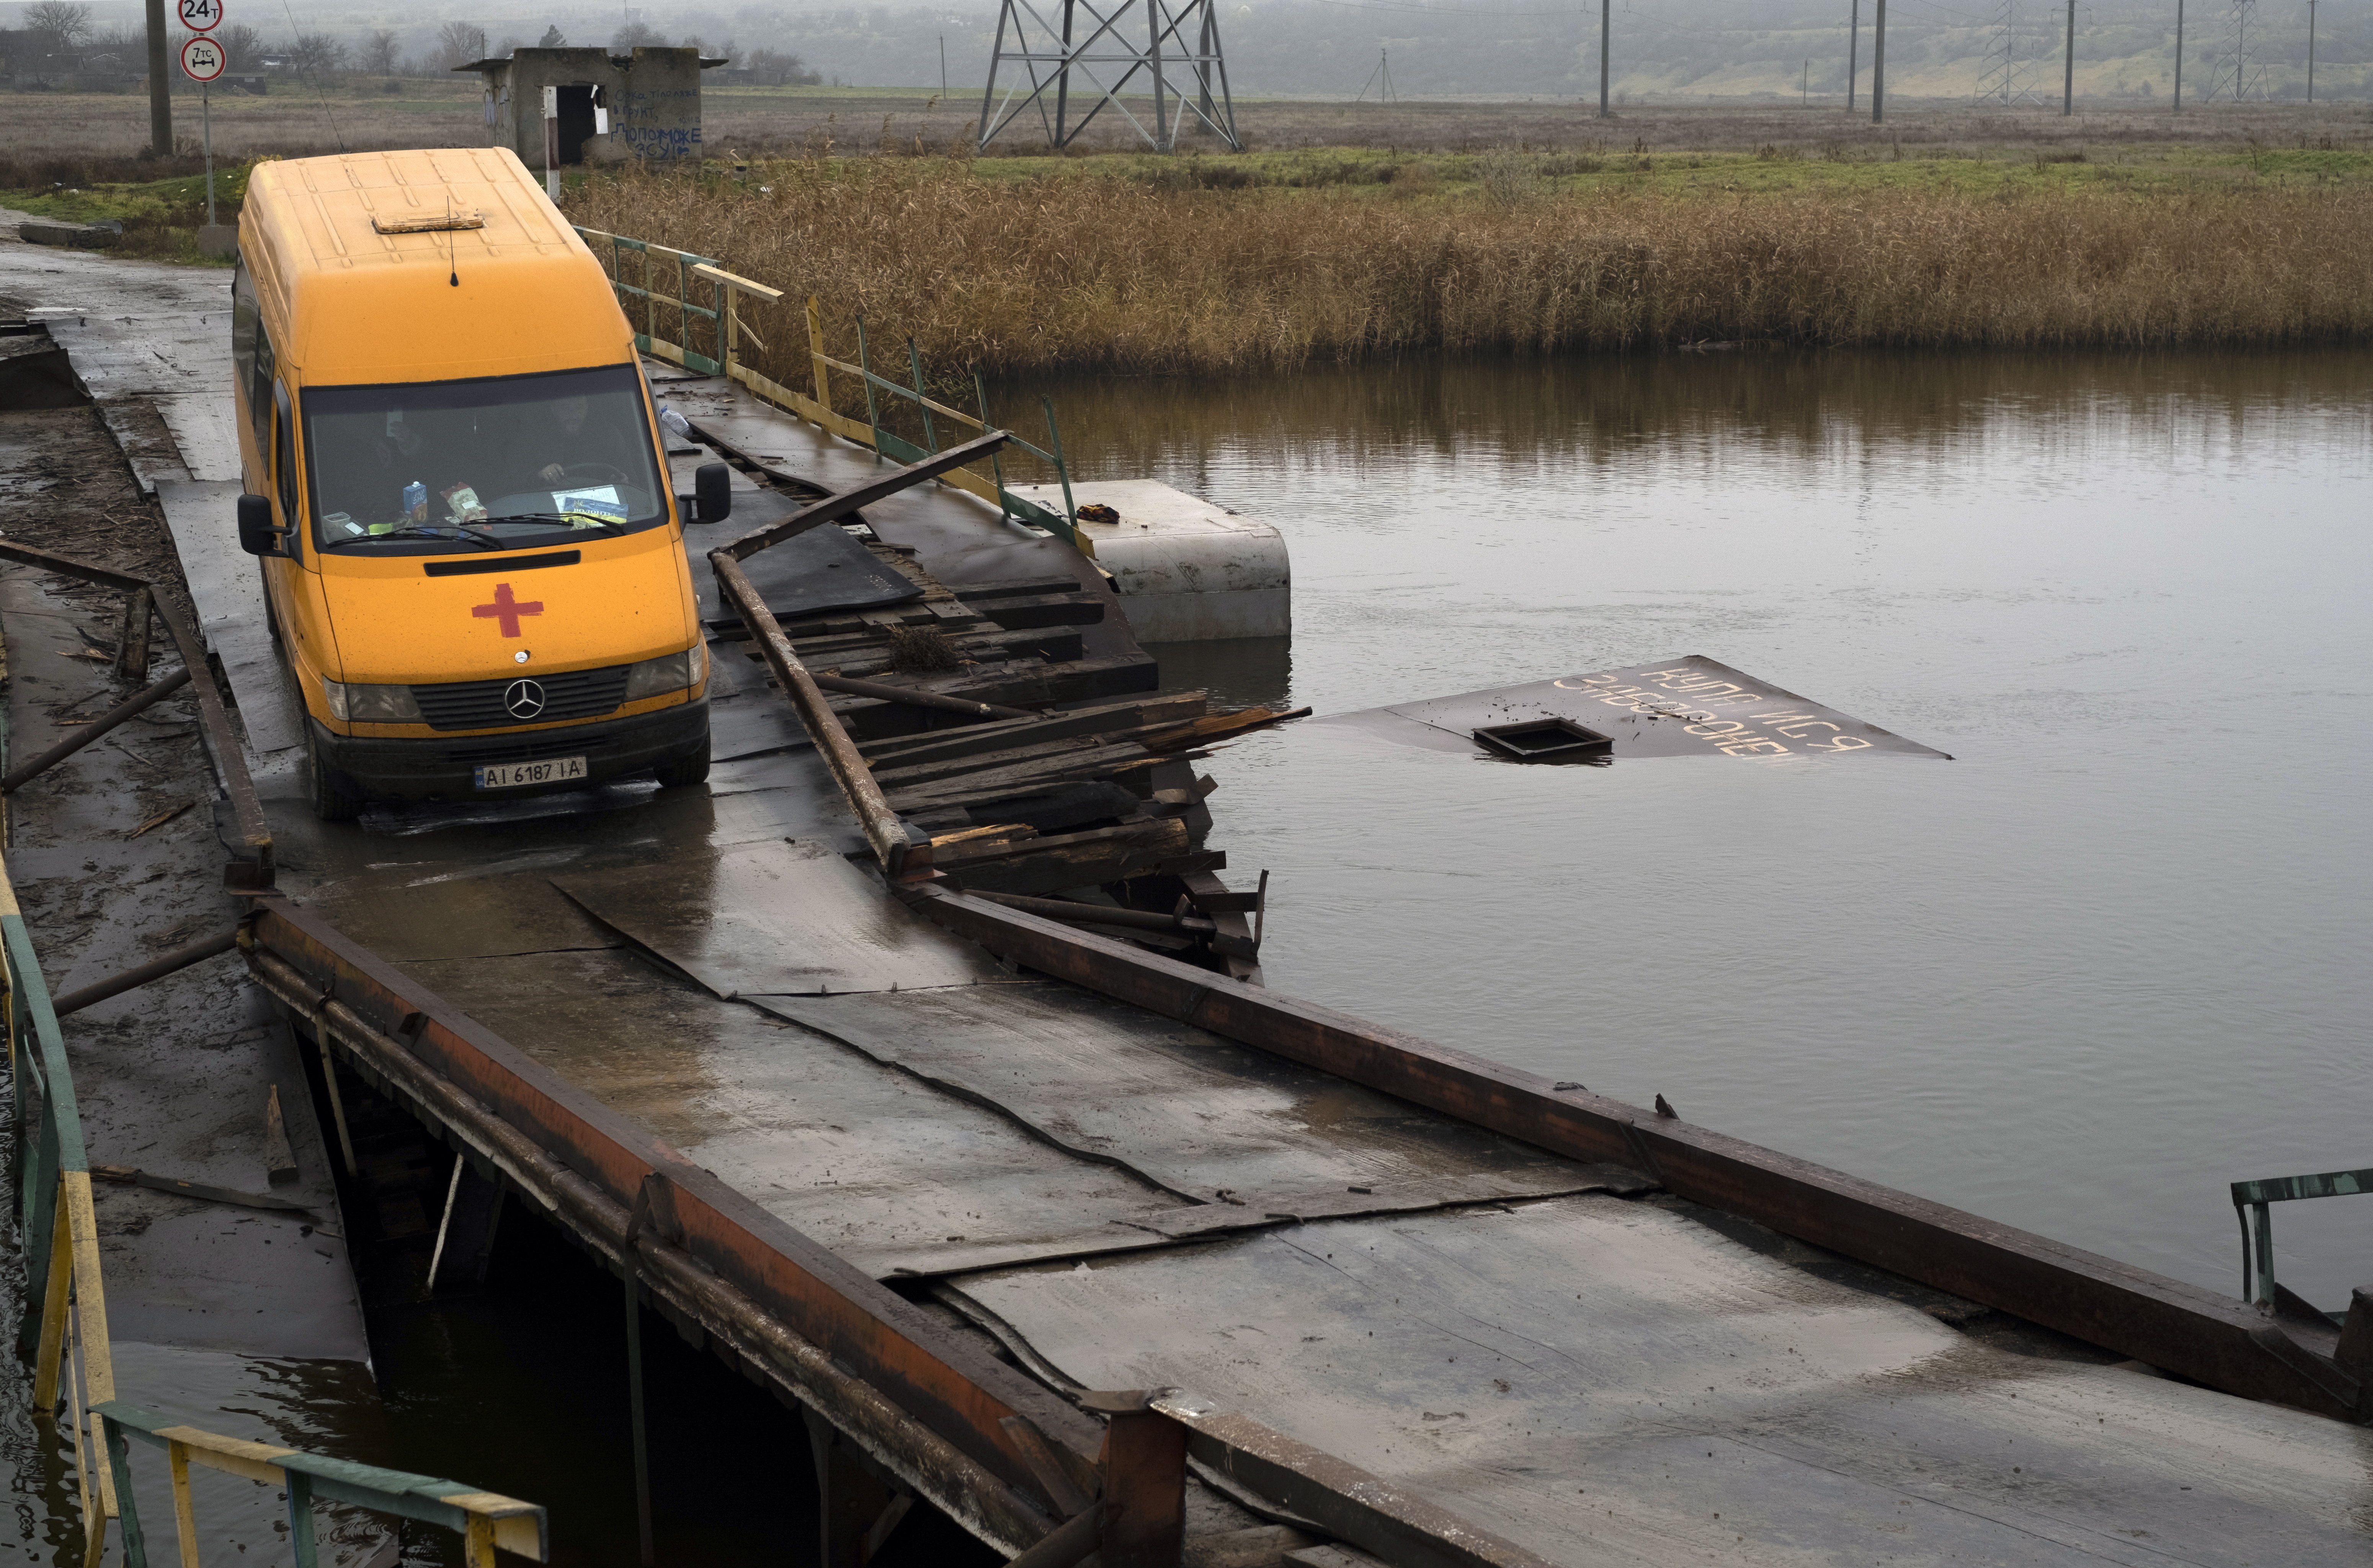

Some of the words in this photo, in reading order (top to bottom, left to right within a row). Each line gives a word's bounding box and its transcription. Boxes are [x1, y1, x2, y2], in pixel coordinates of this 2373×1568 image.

[1639, 668, 1875, 753] КУПАИСЯ
[487, 769, 506, 785] AI
[514, 764, 552, 782] 6187
[560, 760, 580, 777] IA
